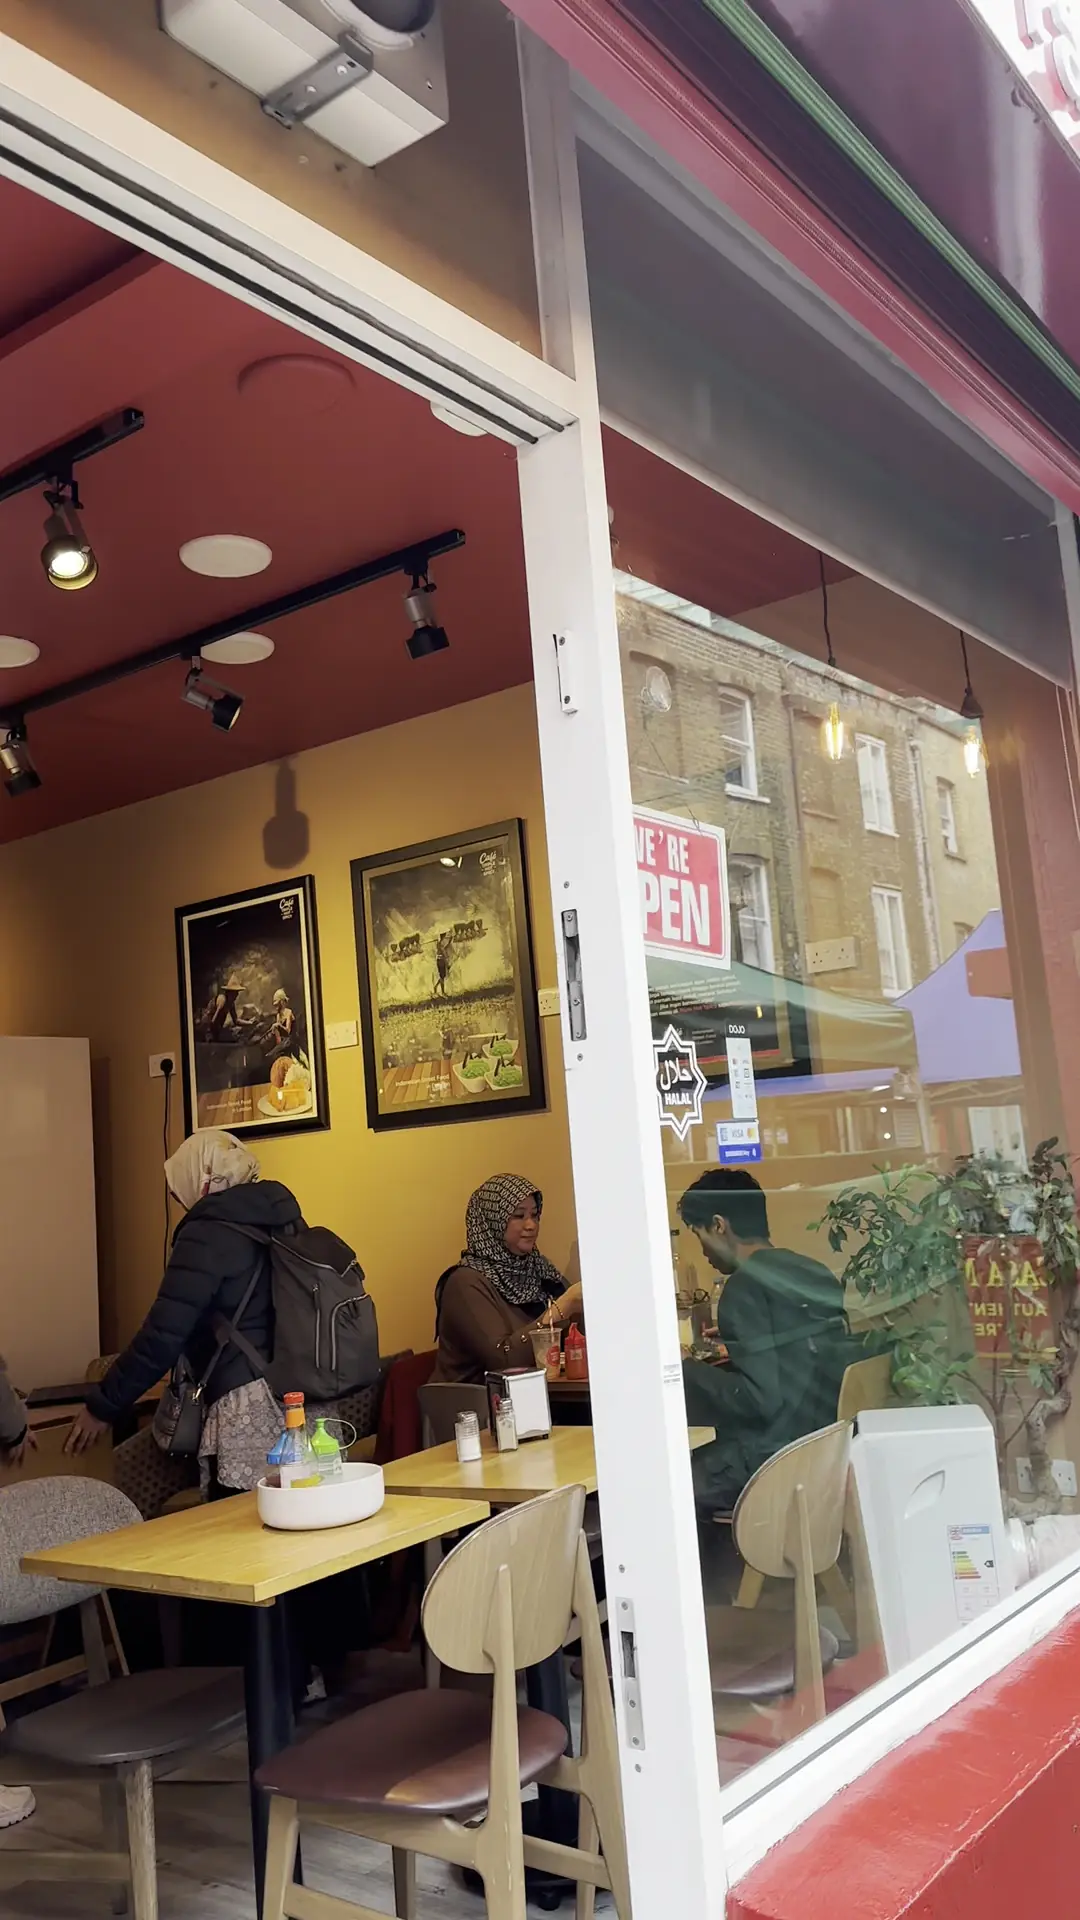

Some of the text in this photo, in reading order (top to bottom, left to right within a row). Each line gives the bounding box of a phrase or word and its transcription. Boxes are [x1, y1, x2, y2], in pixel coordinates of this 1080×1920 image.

[479, 850, 497, 864] Café
[637, 871, 711, 946] PEN
[728, 1024, 746, 1034] DOJO
[659, 1058, 693, 1090] حلال
[664, 1092, 692, 1106] HALAL
